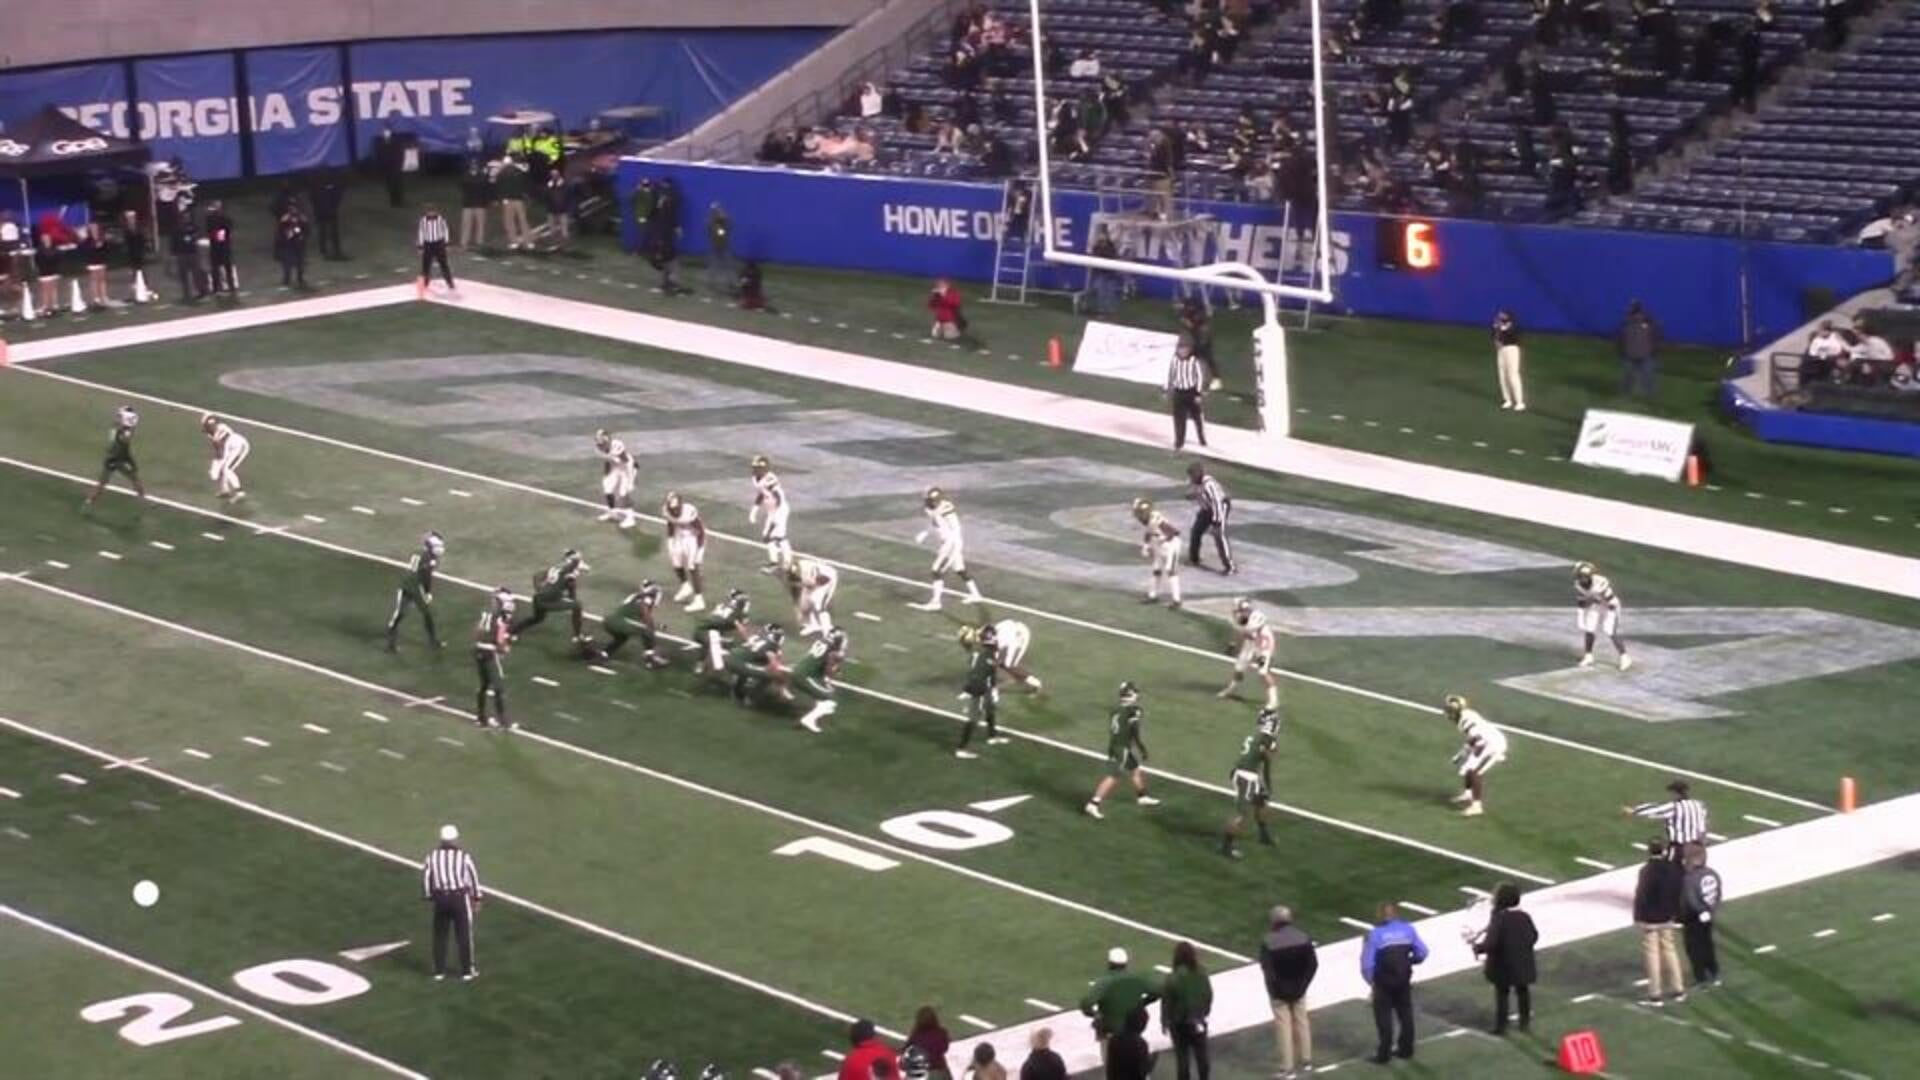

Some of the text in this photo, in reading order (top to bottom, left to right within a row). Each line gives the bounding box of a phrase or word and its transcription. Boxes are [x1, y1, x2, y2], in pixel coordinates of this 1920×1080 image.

[56, 78, 472, 139] EORGIA STATE
[884, 203, 969, 239] HOME
[1405, 223, 1432, 266] 6
